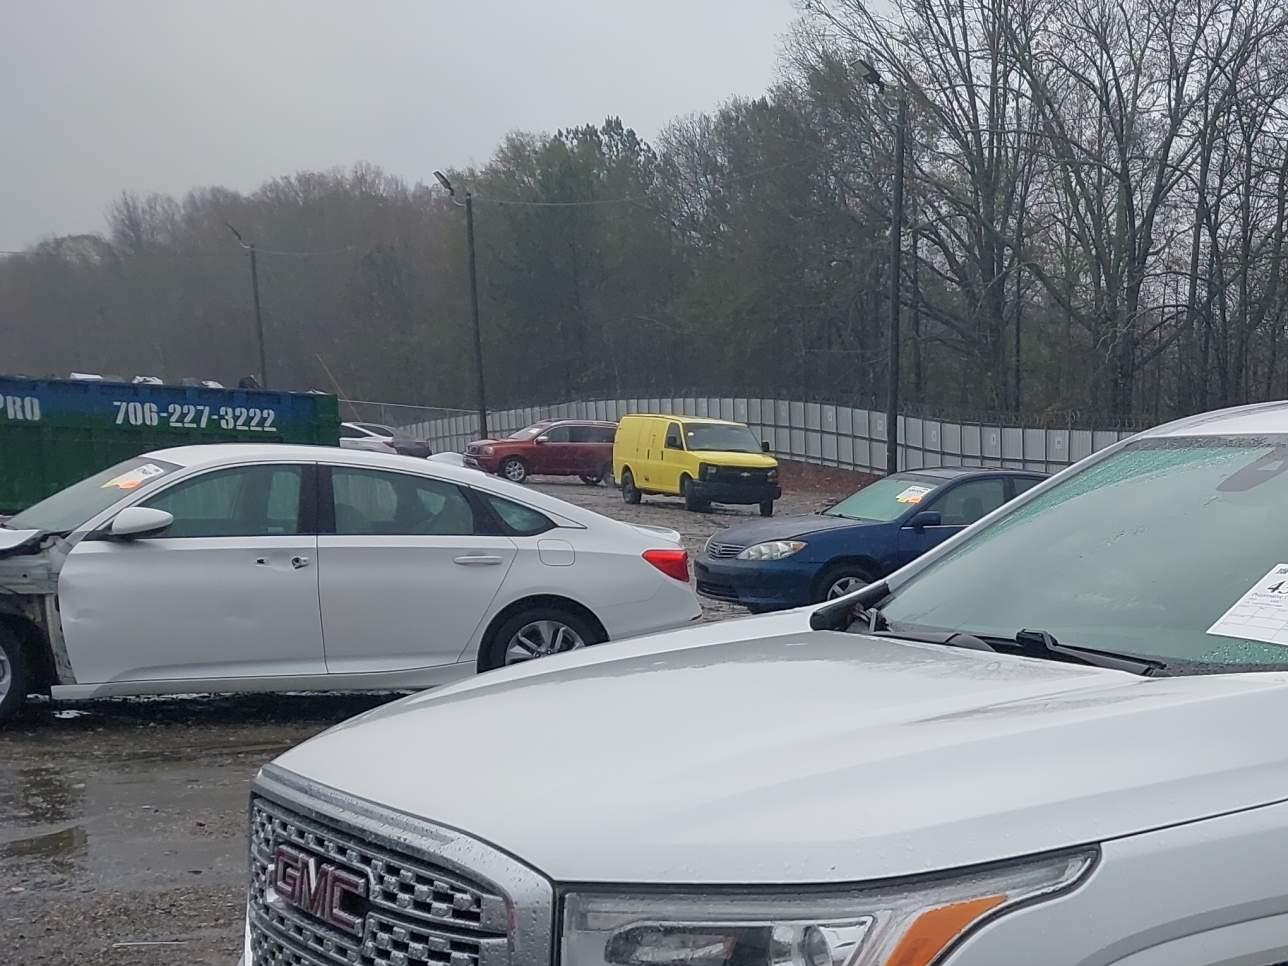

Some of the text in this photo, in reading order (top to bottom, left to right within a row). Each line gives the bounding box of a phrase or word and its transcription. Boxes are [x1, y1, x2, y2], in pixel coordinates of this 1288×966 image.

[0, 393, 277, 432] RO 706-227-3222
[274, 844, 367, 937] GMC
